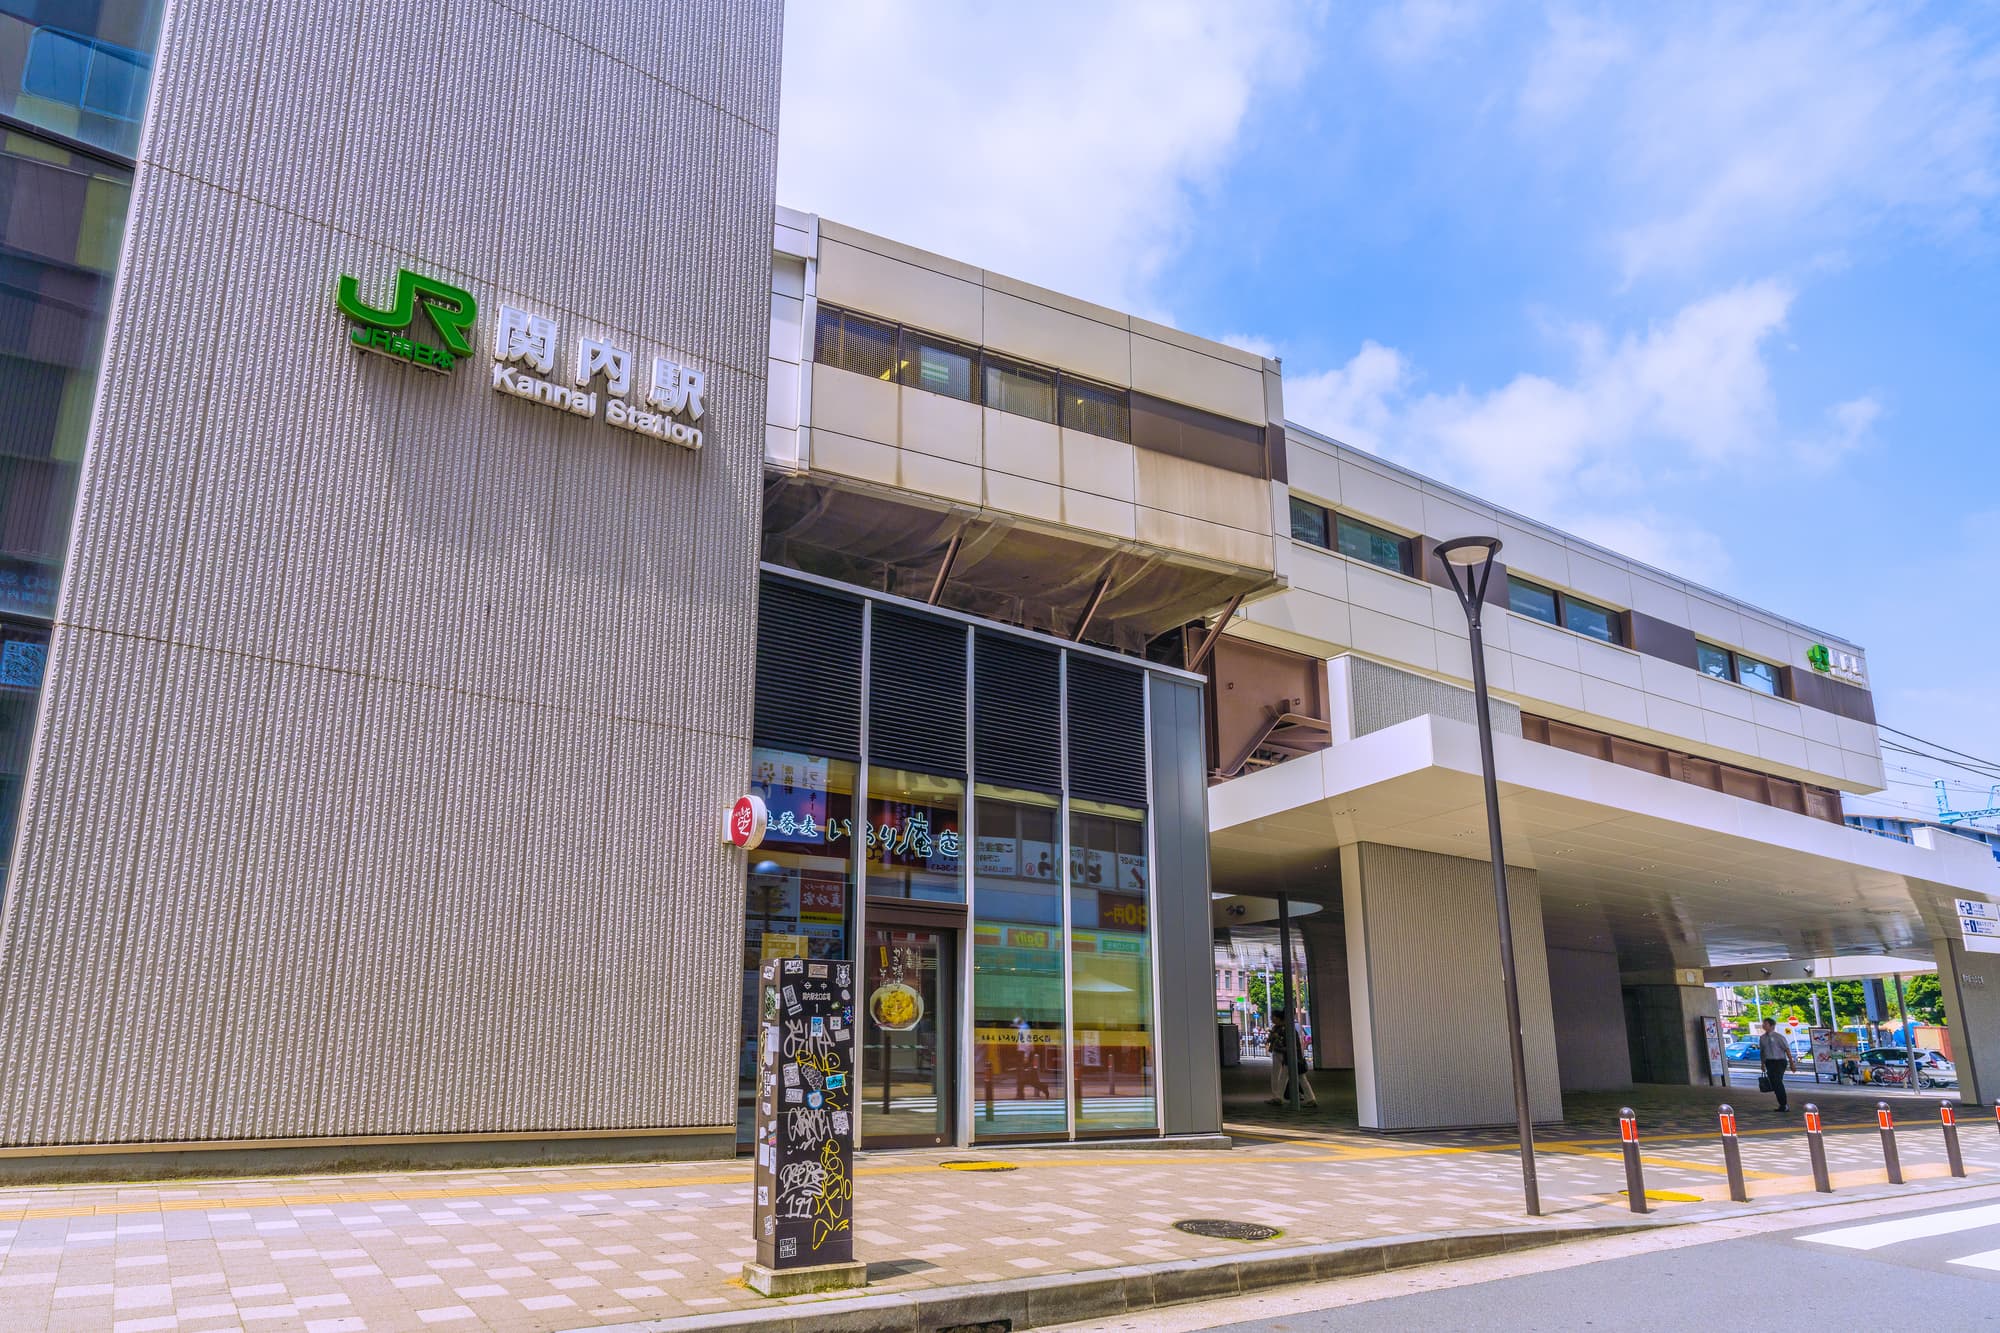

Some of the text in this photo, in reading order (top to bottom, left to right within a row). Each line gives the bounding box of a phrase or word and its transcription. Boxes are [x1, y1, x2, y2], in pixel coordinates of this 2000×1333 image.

[338, 268, 477, 358] JR
[351, 327, 456, 371] JR東日本
[493, 363, 703, 450] Kannai Station
[495, 305, 704, 420] 関内駅
